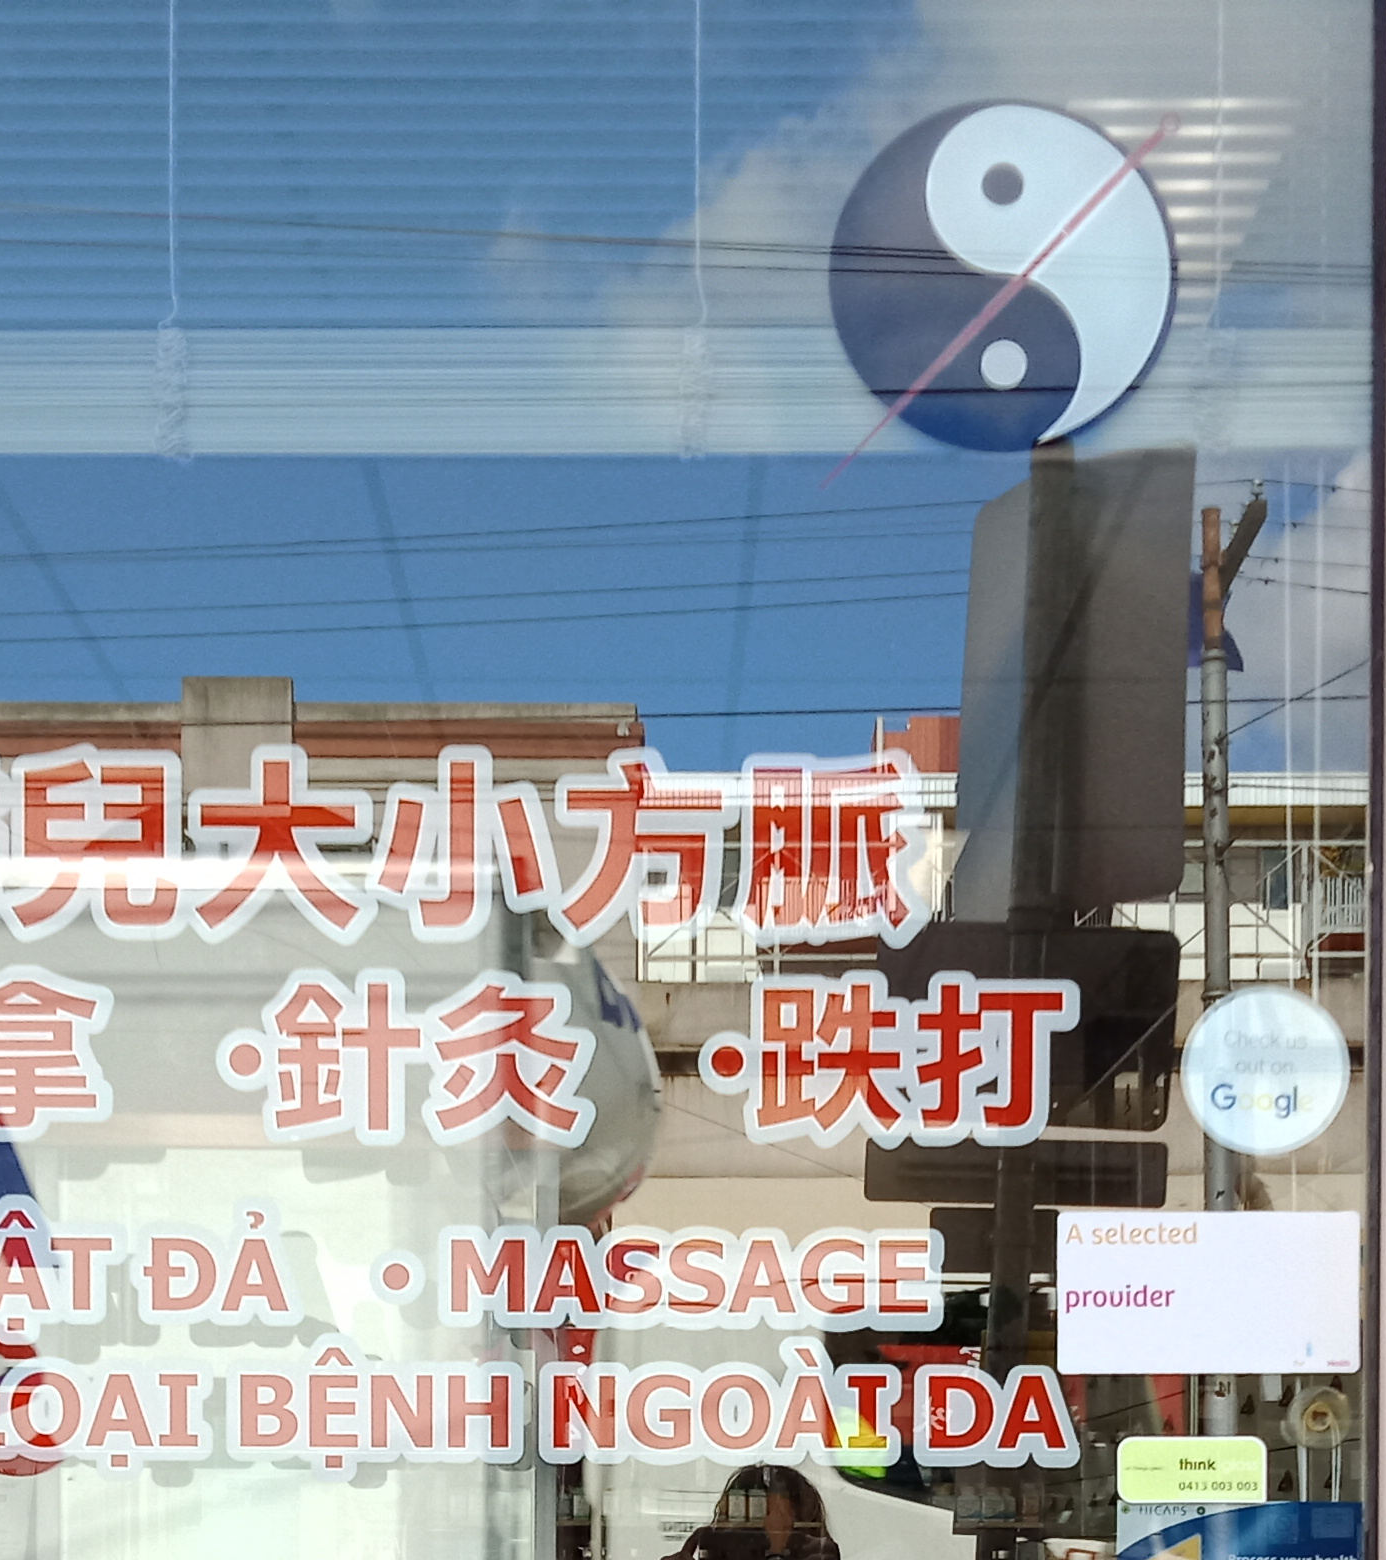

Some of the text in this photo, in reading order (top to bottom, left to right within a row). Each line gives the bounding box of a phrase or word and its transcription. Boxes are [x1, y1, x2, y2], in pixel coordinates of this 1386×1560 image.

[273, 978, 581, 1134] 針灸
[753, 979, 1066, 1134] 跌打
[1210, 1082, 1315, 1119] Google
[1065, 1222, 1199, 1245] A selected
[450, 1237, 932, 1315] MASSAGE
[1064, 1284, 1176, 1314] provider
[238, 1347, 510, 1470] BỆNH
[551, 1347, 888, 1449] NGOÀI
[926, 1374, 1068, 1450] DA
[1179, 1457, 1216, 1471] think
[1139, 1505, 1188, 1517] HICAPS
